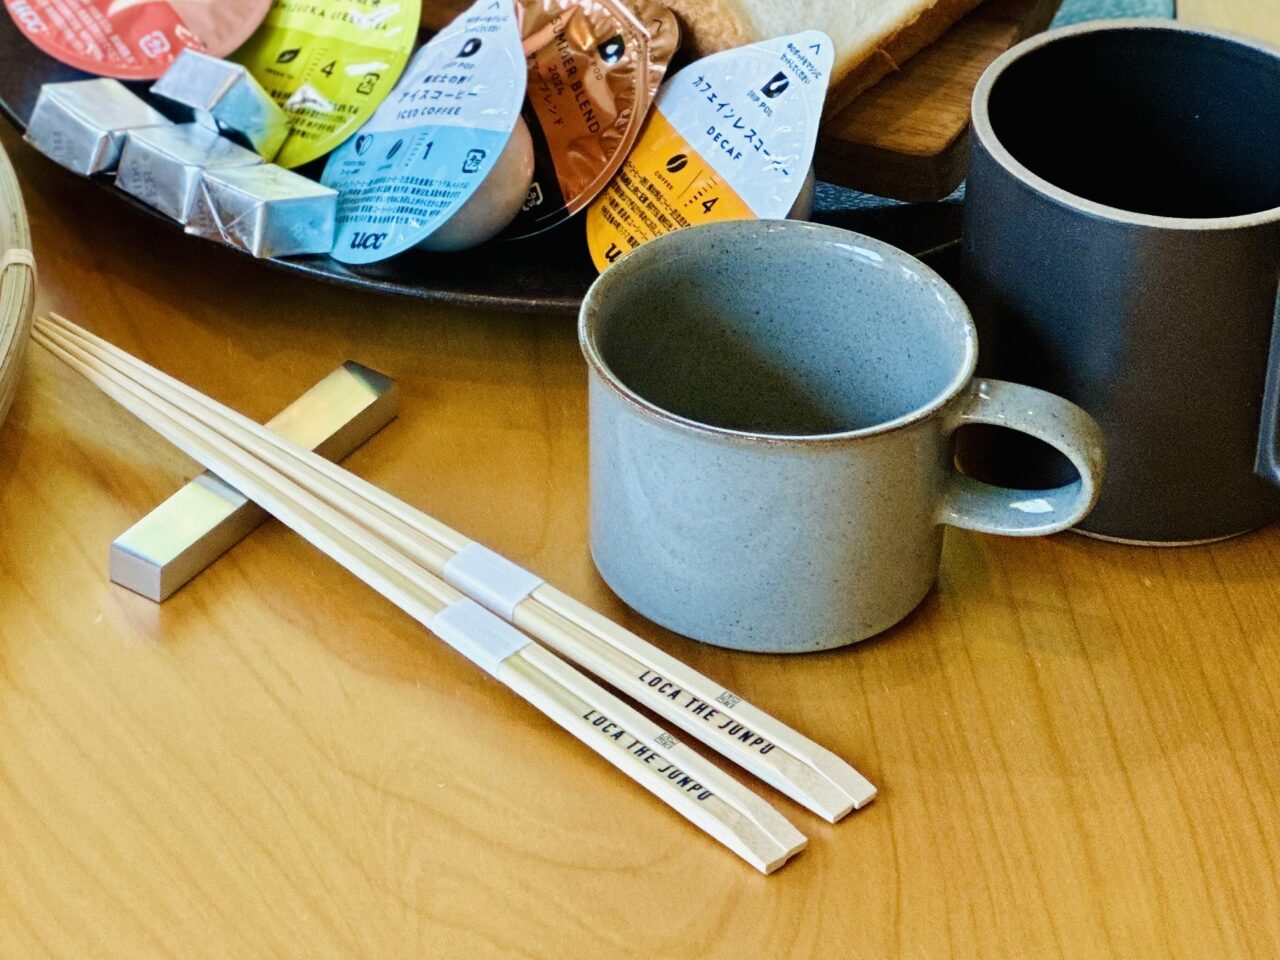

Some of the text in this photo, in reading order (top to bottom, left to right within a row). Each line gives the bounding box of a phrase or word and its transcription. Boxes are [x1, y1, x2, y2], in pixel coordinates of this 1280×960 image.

[320, 60, 337, 78] 4
[546, 64, 565, 96] 2024
[397, 89, 479, 104] アイスコーヒー
[570, 79, 602, 135] BLEND
[396, 105, 463, 121] ICED COFFEE
[422, 140, 434, 161] 1
[706, 124, 743, 162] DECAF
[701, 196, 720, 215] 4
[638, 670, 776, 756] LOCA THE JUNPU
[582, 709, 714, 802] LOCA THE JUNPU
